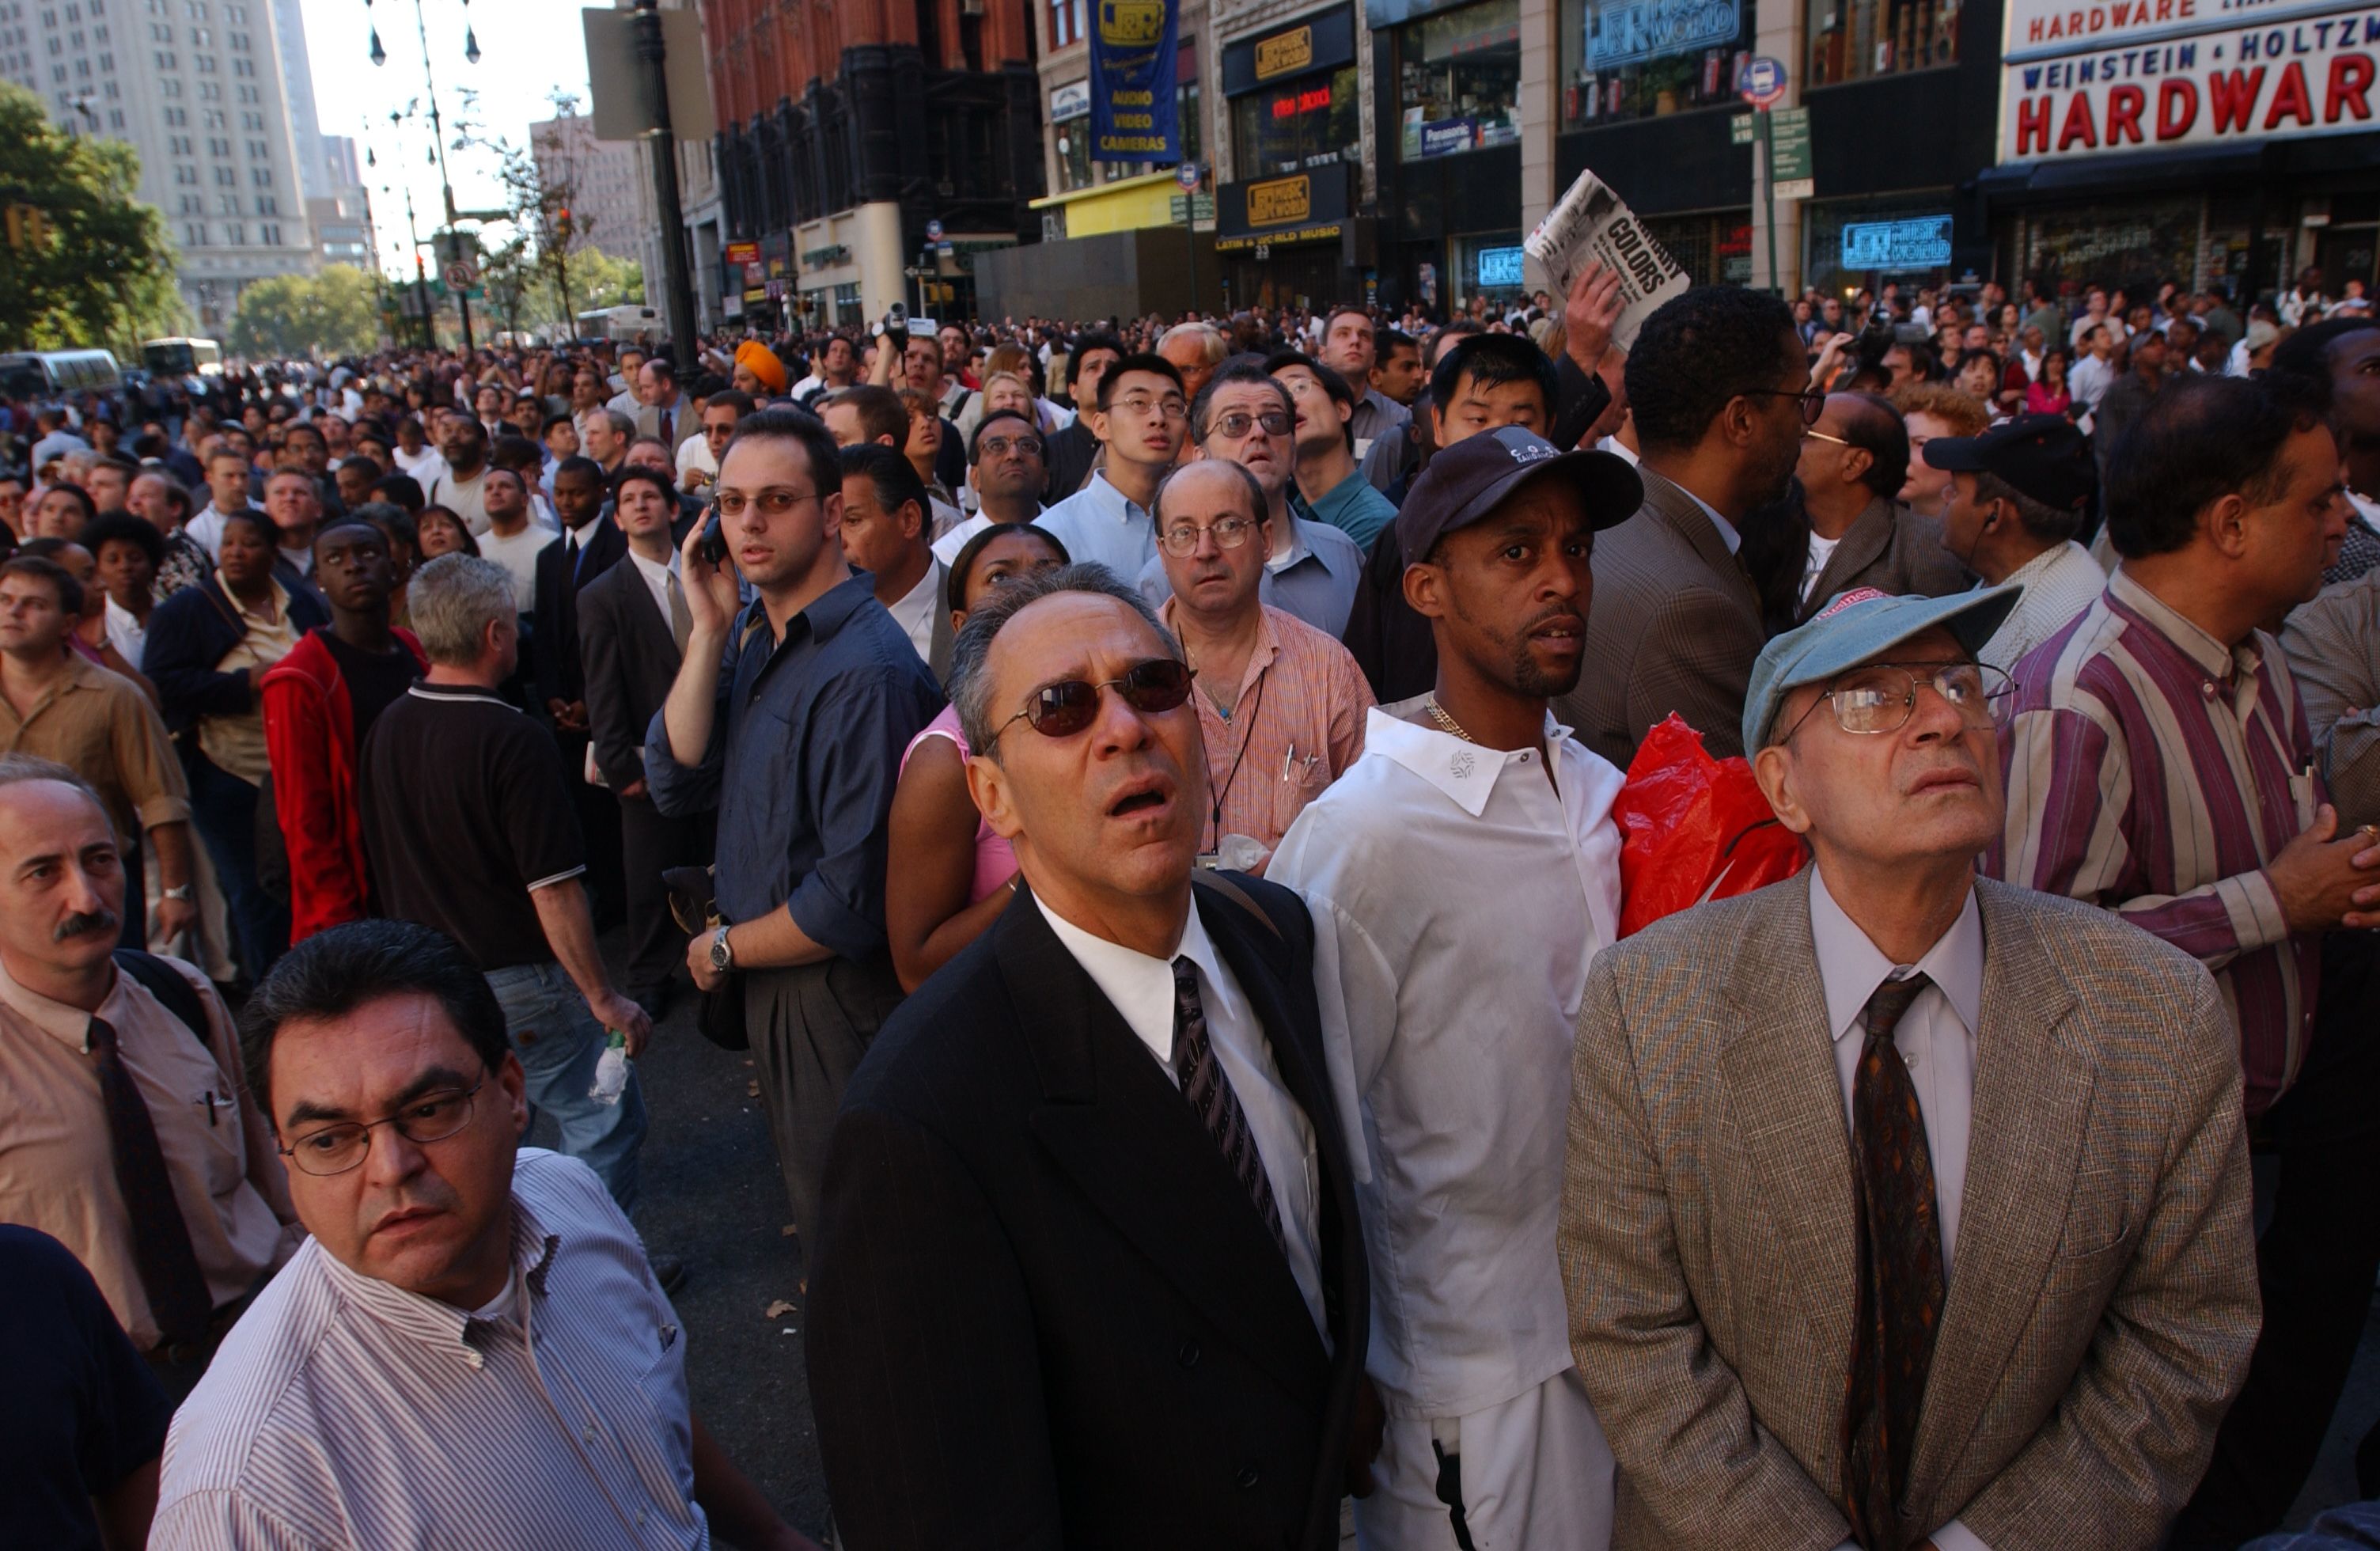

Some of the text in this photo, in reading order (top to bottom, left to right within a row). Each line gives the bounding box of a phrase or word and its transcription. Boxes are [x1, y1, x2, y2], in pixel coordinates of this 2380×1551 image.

[1651, 3, 1734, 47] WORLD
[2029, 0, 2195, 41] HARDWARE
[2023, 43, 2196, 90] WEINSTEIN
[1112, 90, 1153, 107] AUDIO
[2016, 52, 2377, 155] HARDWAR
[1113, 113, 1153, 129] VIDEO
[1427, 122, 1470, 142] Panasonic
[1100, 135, 1166, 152] CAMERAS
[1215, 239, 1245, 251] LATIN
[1256, 231, 1298, 245] WORLD
[1299, 226, 1340, 238] MUSIC
[1891, 221, 1942, 241] MUSIC
[1607, 217, 1666, 295] COLORS
[1891, 239, 1952, 261] WORLD
